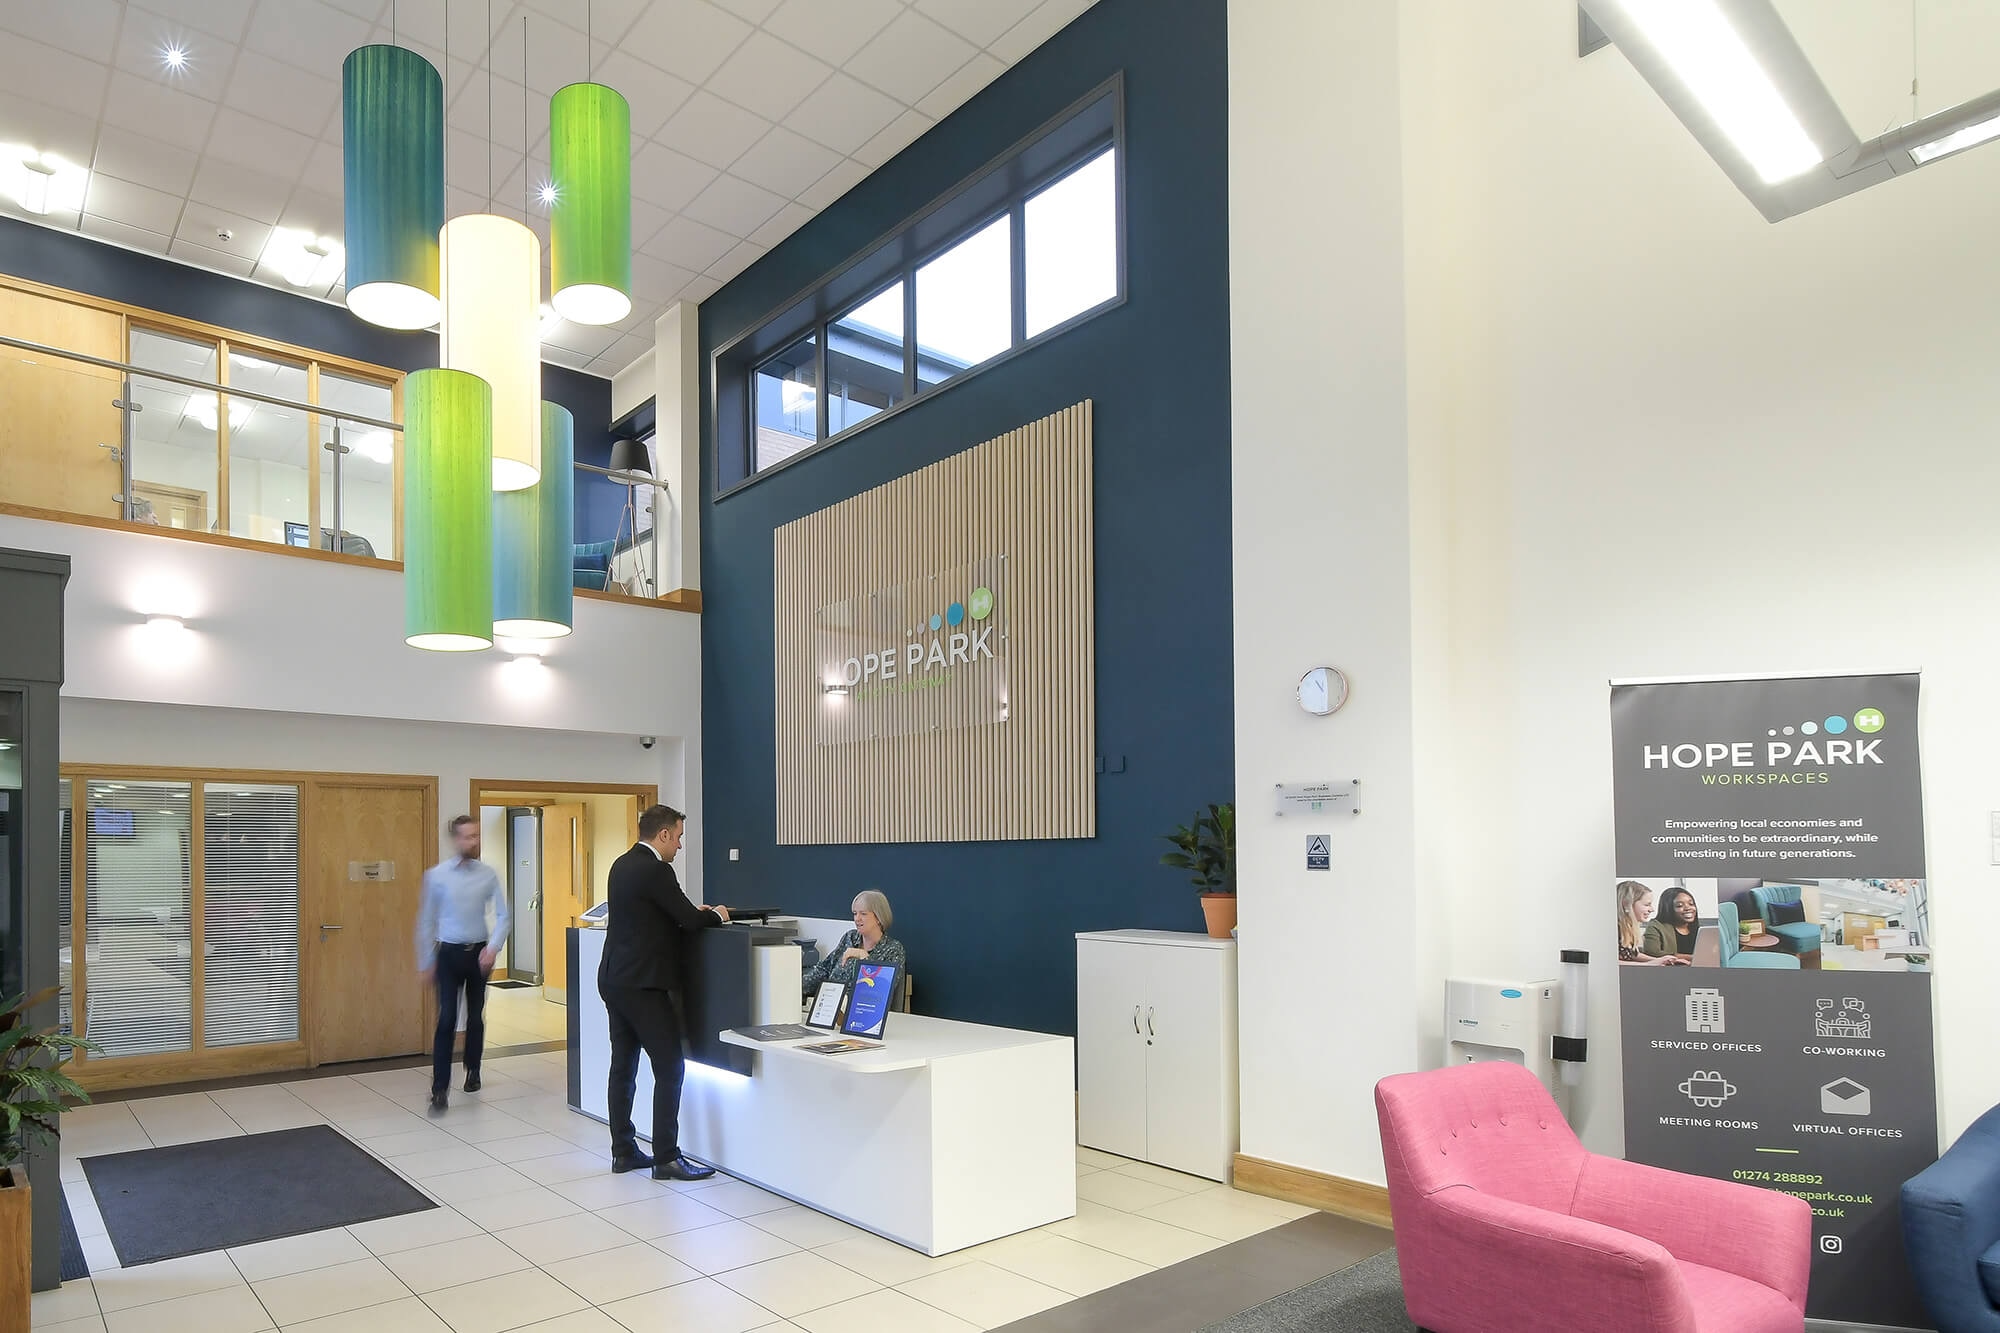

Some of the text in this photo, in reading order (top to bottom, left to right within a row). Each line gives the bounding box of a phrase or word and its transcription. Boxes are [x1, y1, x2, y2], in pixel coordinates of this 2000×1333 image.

[842, 626, 994, 688] OPE PARK
[1858, 714, 1880, 726] H
[1643, 739, 1885, 769] HOPE PARK
[1701, 772, 1829, 785] WORKSPACES
[1665, 818, 1863, 830] Empowering local economies and
[1651, 833, 1879, 844] communities to be extraordinary, while
[1673, 848, 1856, 859] investing in future generations.
[1650, 1040, 1762, 1052] SERVICED OFFICES
[1802, 1046, 1886, 1058] CO-WORKING
[1659, 1117, 1759, 1130] MEETING ROOMS
[1792, 1124, 1903, 1138] VIRTUAL OFFICES
[1732, 1169, 1823, 1185] 01274 288892
